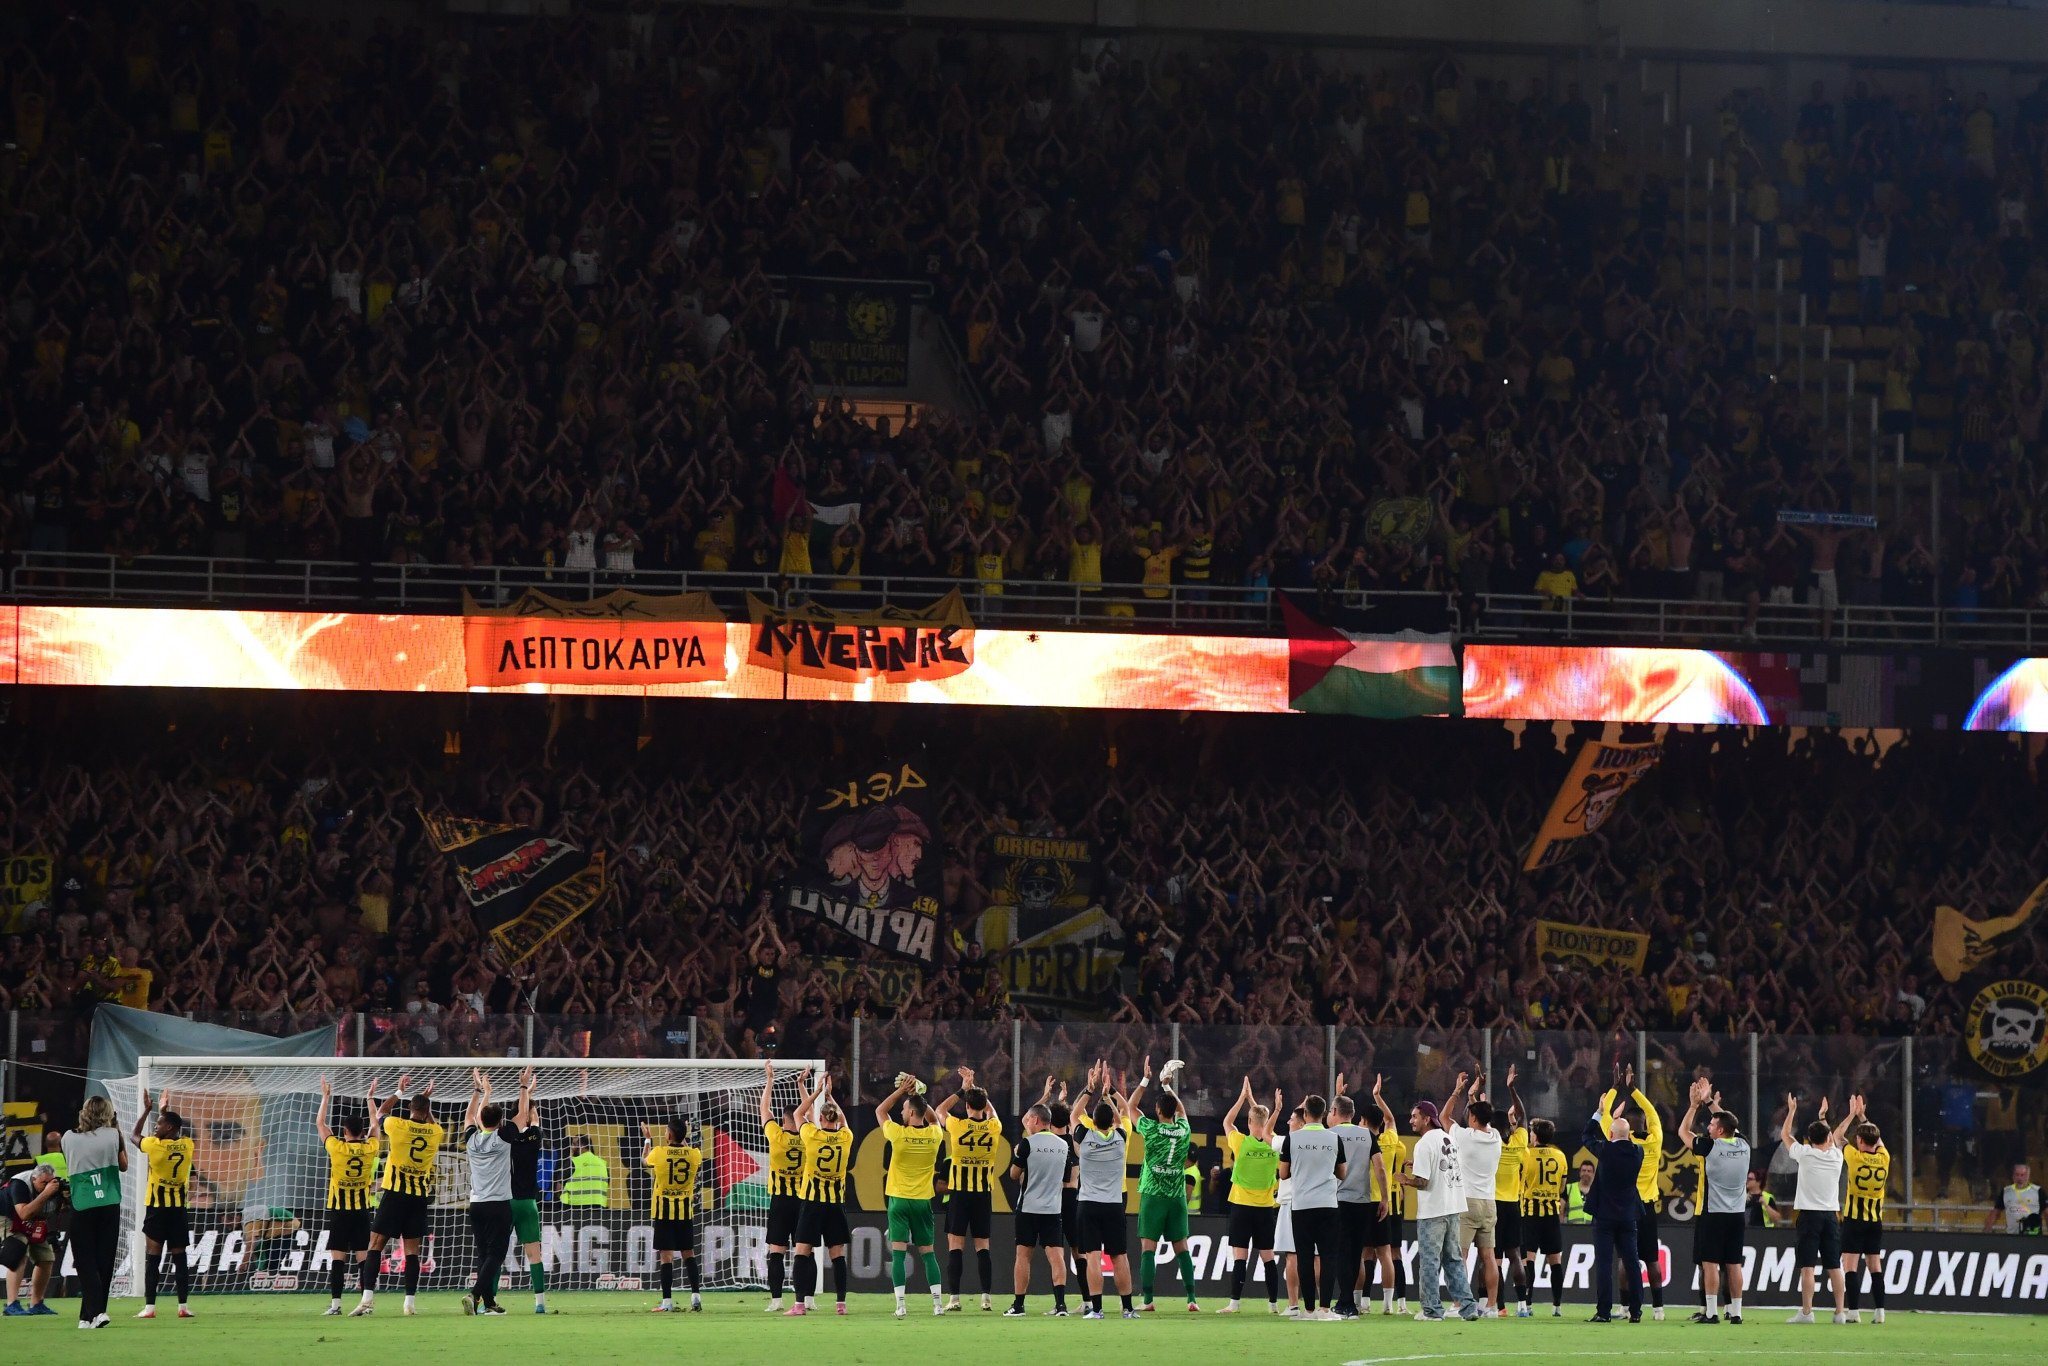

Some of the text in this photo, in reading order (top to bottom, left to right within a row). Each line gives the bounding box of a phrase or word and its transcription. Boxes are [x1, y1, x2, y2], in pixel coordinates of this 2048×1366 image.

[498, 636, 706, 673] ΛΕΠΤΟΚΑΡΥΑ
[995, 835, 1091, 861] ORIGINAL
[409, 1136, 428, 1163] 2
[958, 1130, 993, 1152] 44
[1165, 1137, 1178, 1165] 1
[167, 1152, 184, 1179] 7
[345, 1157, 364, 1178] 3
[666, 1158, 690, 1185] 13
[786, 1147, 803, 1171] 9
[816, 1145, 842, 1173] 21
[1535, 1157, 1559, 1186] 12
[90, 1173, 102, 1186] TV
[1855, 1165, 1888, 1191] 29
